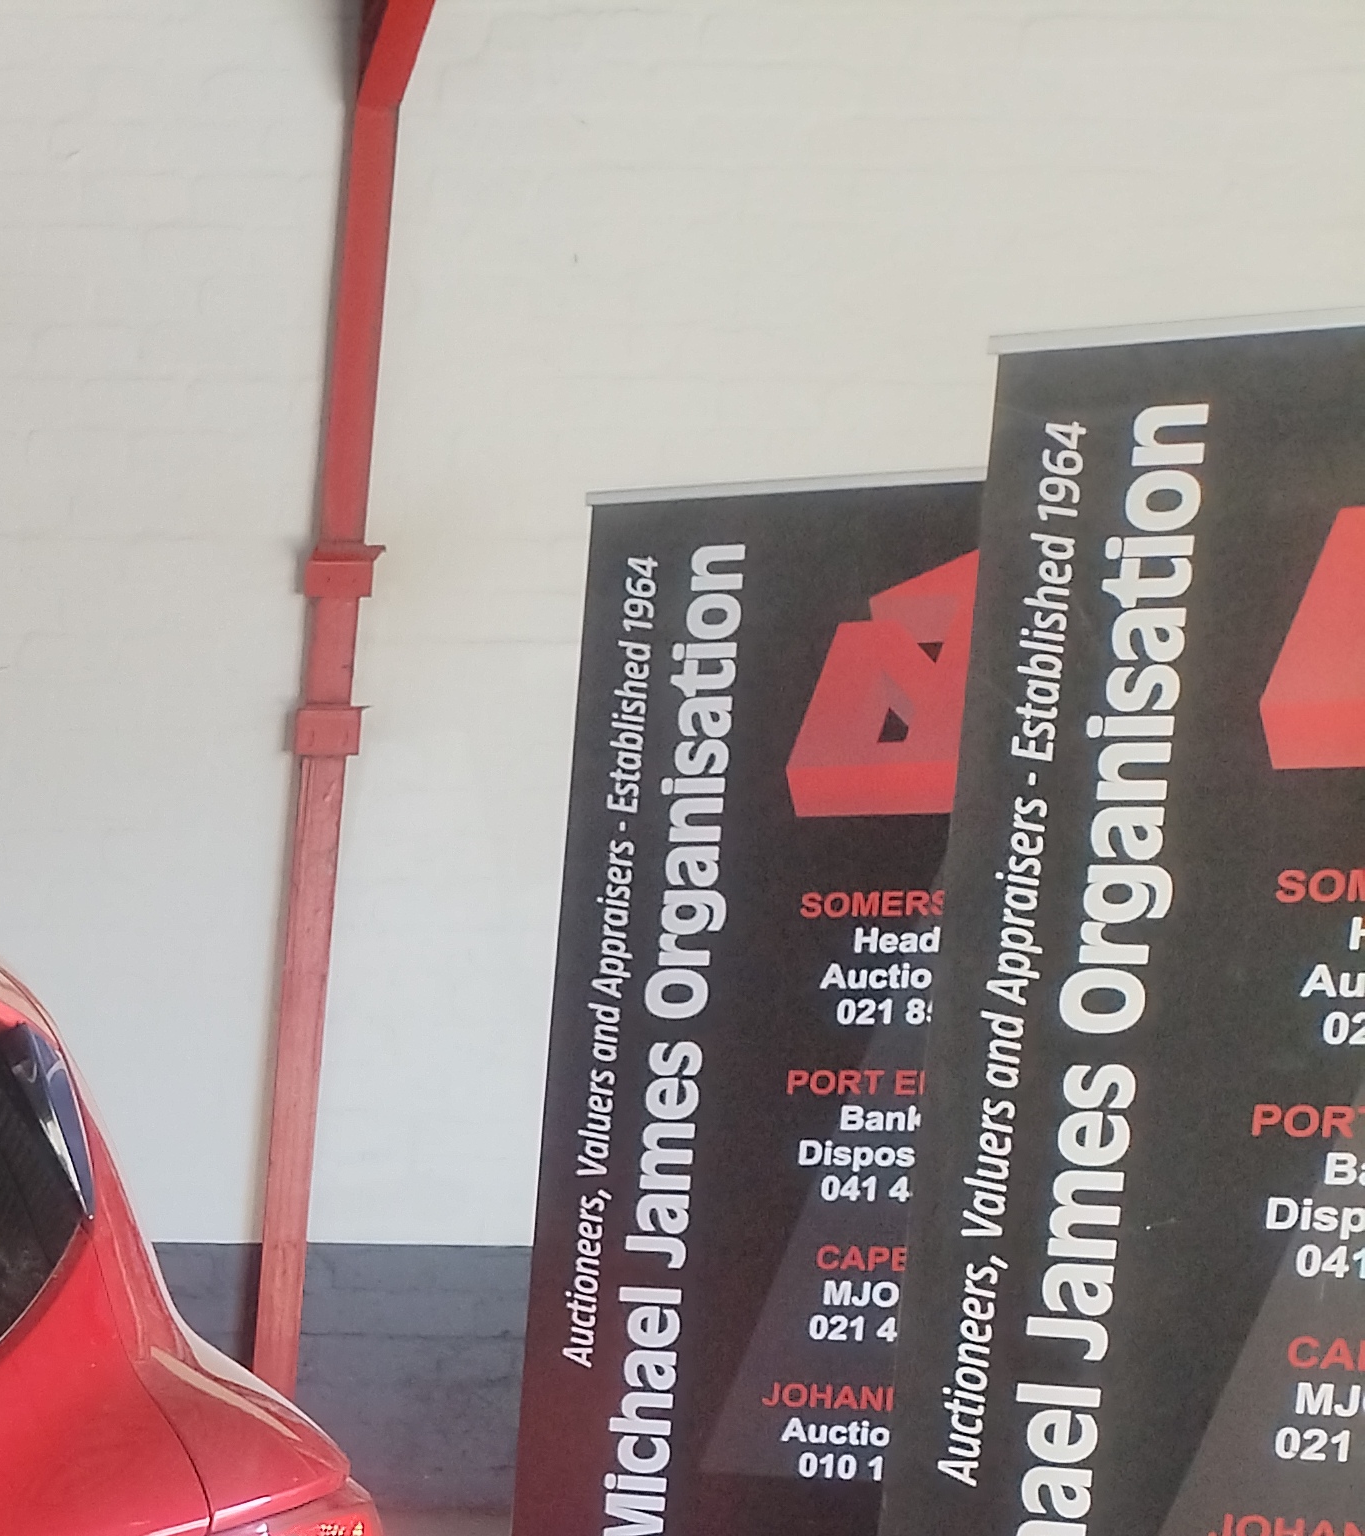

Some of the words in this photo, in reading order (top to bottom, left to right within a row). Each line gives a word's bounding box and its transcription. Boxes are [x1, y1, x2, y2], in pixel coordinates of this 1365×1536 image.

[1038, 422, 1086, 520] 1964
[623, 557, 658, 631] 1964
[1011, 533, 1075, 761] Established
[607, 640, 651, 813] Established
[1059, 403, 1209, 1034] Organisation
[645, 544, 746, 1020] Organisation
[986, 780, 1048, 1005] Appraisers
[592, 840, 634, 998] Appraisers
[854, 926, 940, 953] Head
[820, 963, 932, 989] Auctio
[588, 1003, 620, 1061] and
[837, 999, 892, 1024] 021
[981, 1011, 1024, 1088] and
[787, 1070, 885, 1095] PORT
[576, 1069, 614, 1175] Valuers
[1251, 1104, 1365, 1138] POR
[625, 1042, 702, 1268] James
[798, 1140, 915, 1172] Dispos
[961, 1098, 1015, 1236] Valuers
[1324, 1152, 1365, 1186] B
[821, 1176, 876, 1201] 041
[888, 1175, 912, 1202] 4
[1026, 1064, 1135, 1360] James
[563, 1190, 611, 1367] Auctioneers,
[816, 1244, 907, 1272] CAPE
[823, 1281, 899, 1307] MJO
[810, 1315, 864, 1341] 021
[877, 1317, 897, 1341] 4
[938, 1256, 1008, 1486] Auctioneers,
[1287, 1335, 1365, 1371] CA
[1294, 1381, 1365, 1418] MJ
[781, 1418, 889, 1446] Auctio
[1276, 1427, 1350, 1462] 021
[799, 1452, 856, 1479] 010
[868, 1456, 883, 1480] 1
